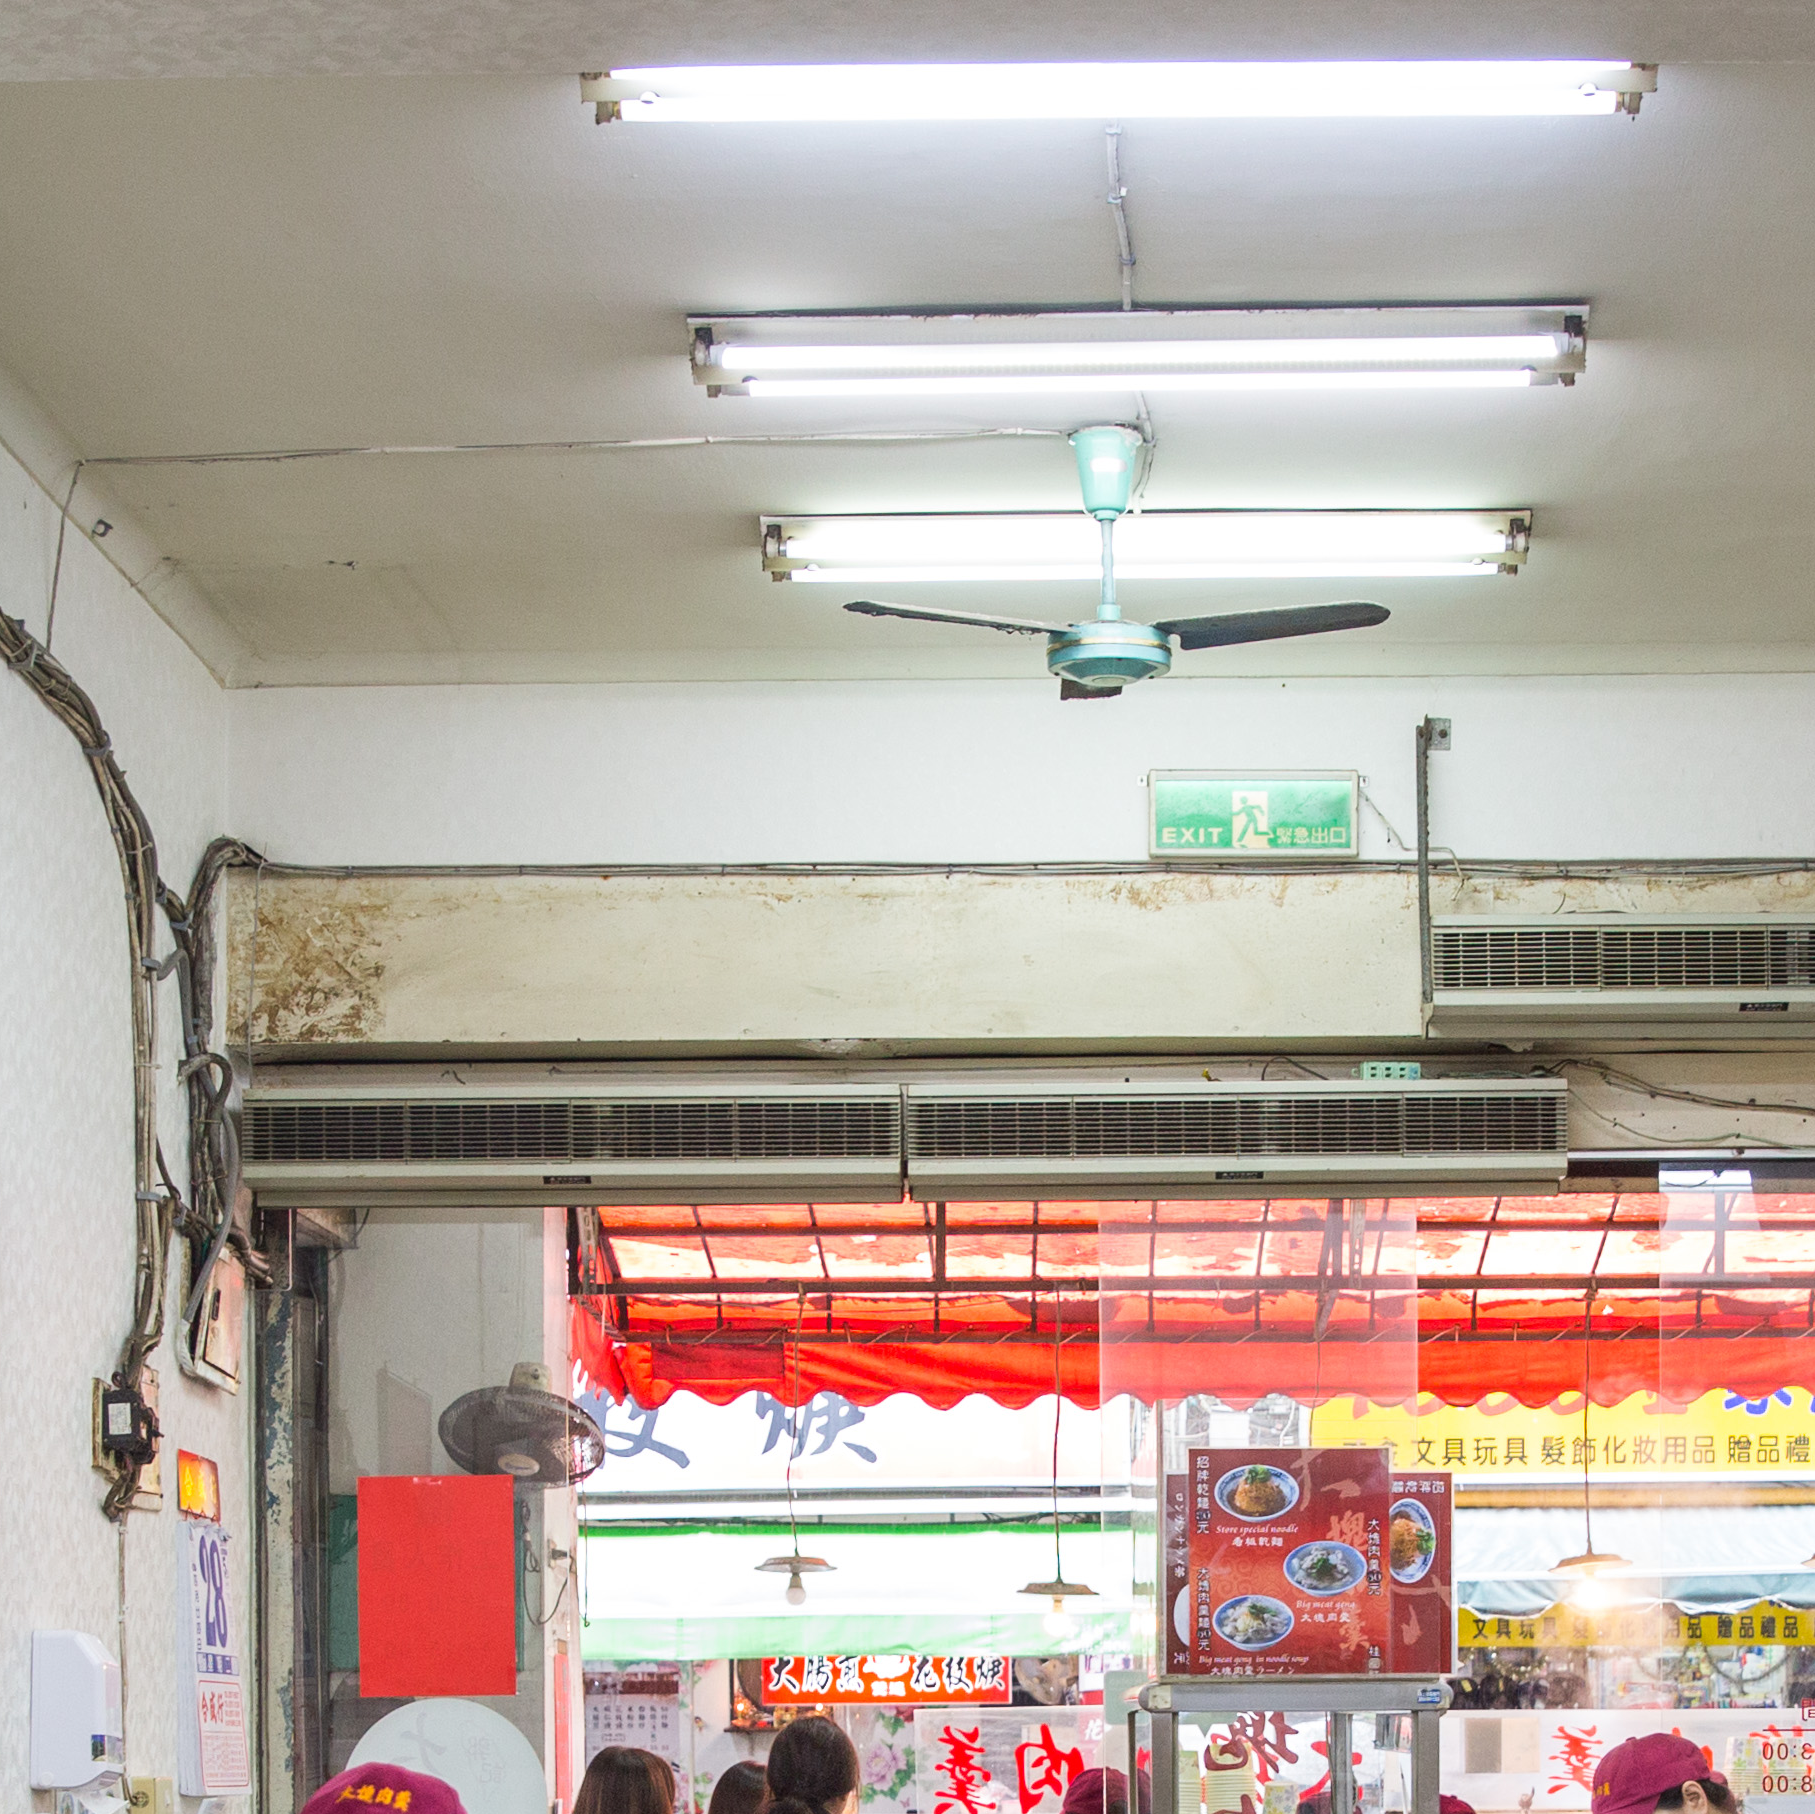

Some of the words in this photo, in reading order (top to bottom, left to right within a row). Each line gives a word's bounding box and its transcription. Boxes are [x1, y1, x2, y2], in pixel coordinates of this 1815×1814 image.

[1161, 827, 1223, 844] EXIT
[1276, 826, 1346, 845] 緊急出口
[1416, 1436, 1528, 1466] 文具玩具
[1216, 1525, 1240, 1535] Store
[1242, 1524, 1269, 1537] special
[1271, 1524, 1299, 1535] noodle
[199, 1534, 228, 1648] 28
[1296, 1600, 1310, 1611] Big
[1312, 1601, 1333, 1609] meat
[1198, 1655, 1212, 1667] Big
[1214, 1656, 1235, 1664] meat
[1266, 1654, 1290, 1664] noodle
